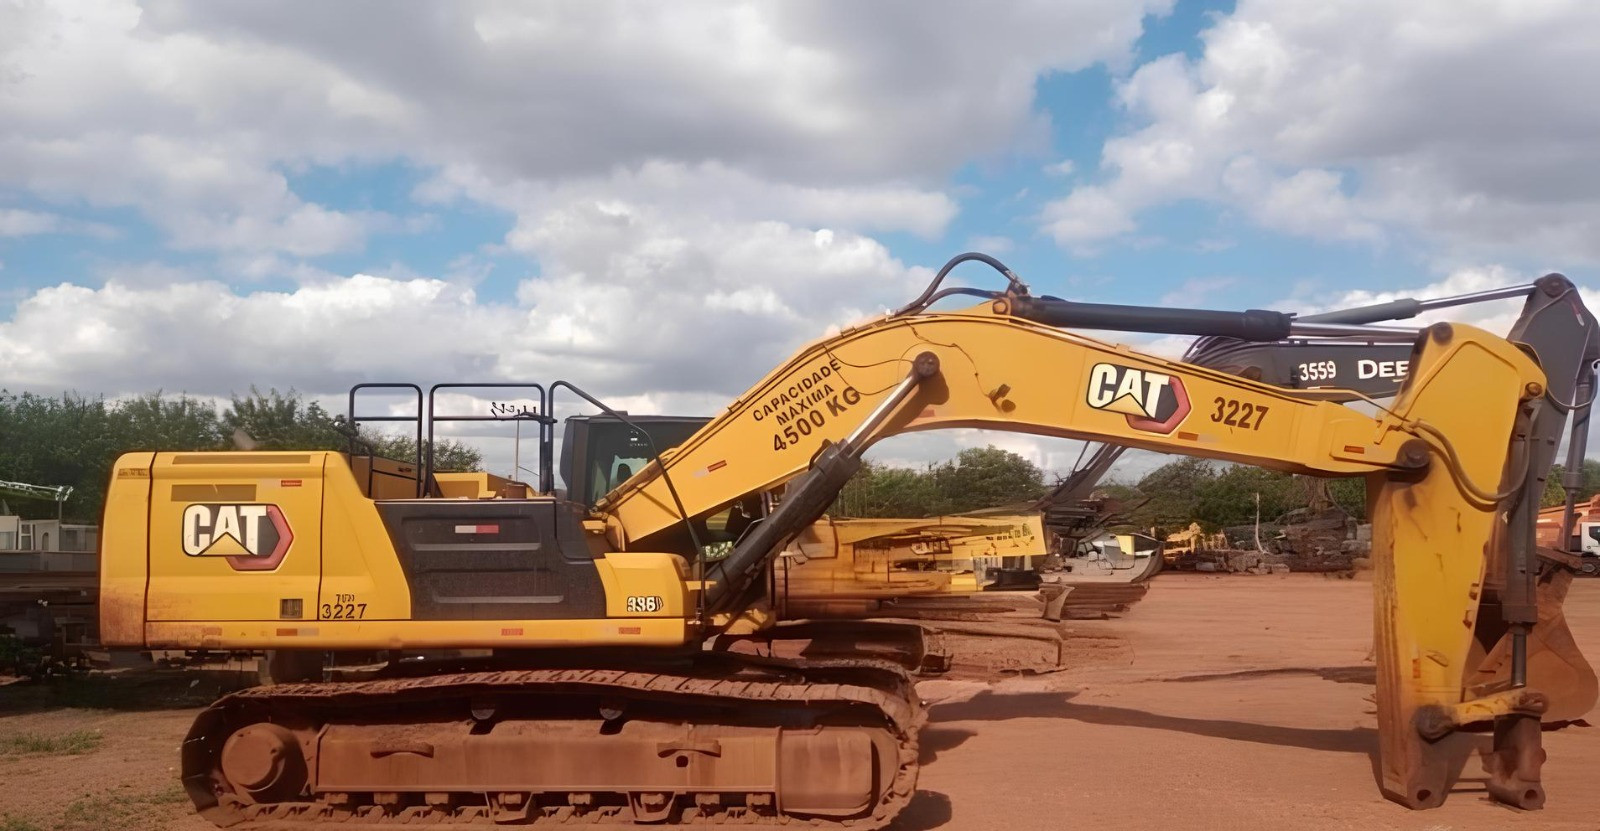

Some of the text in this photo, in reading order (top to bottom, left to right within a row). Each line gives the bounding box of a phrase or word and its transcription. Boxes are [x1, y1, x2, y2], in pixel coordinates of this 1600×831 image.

[753, 359, 842, 421] CAPACIDADE
[1087, 363, 1171, 419] CAT
[1298, 359, 1410, 381] 3559 DEE
[774, 386, 861, 451] 4500 KG
[1210, 396, 1270, 431] 3227
[183, 503, 267, 556] CAT
[322, 603, 368, 619] 3227
